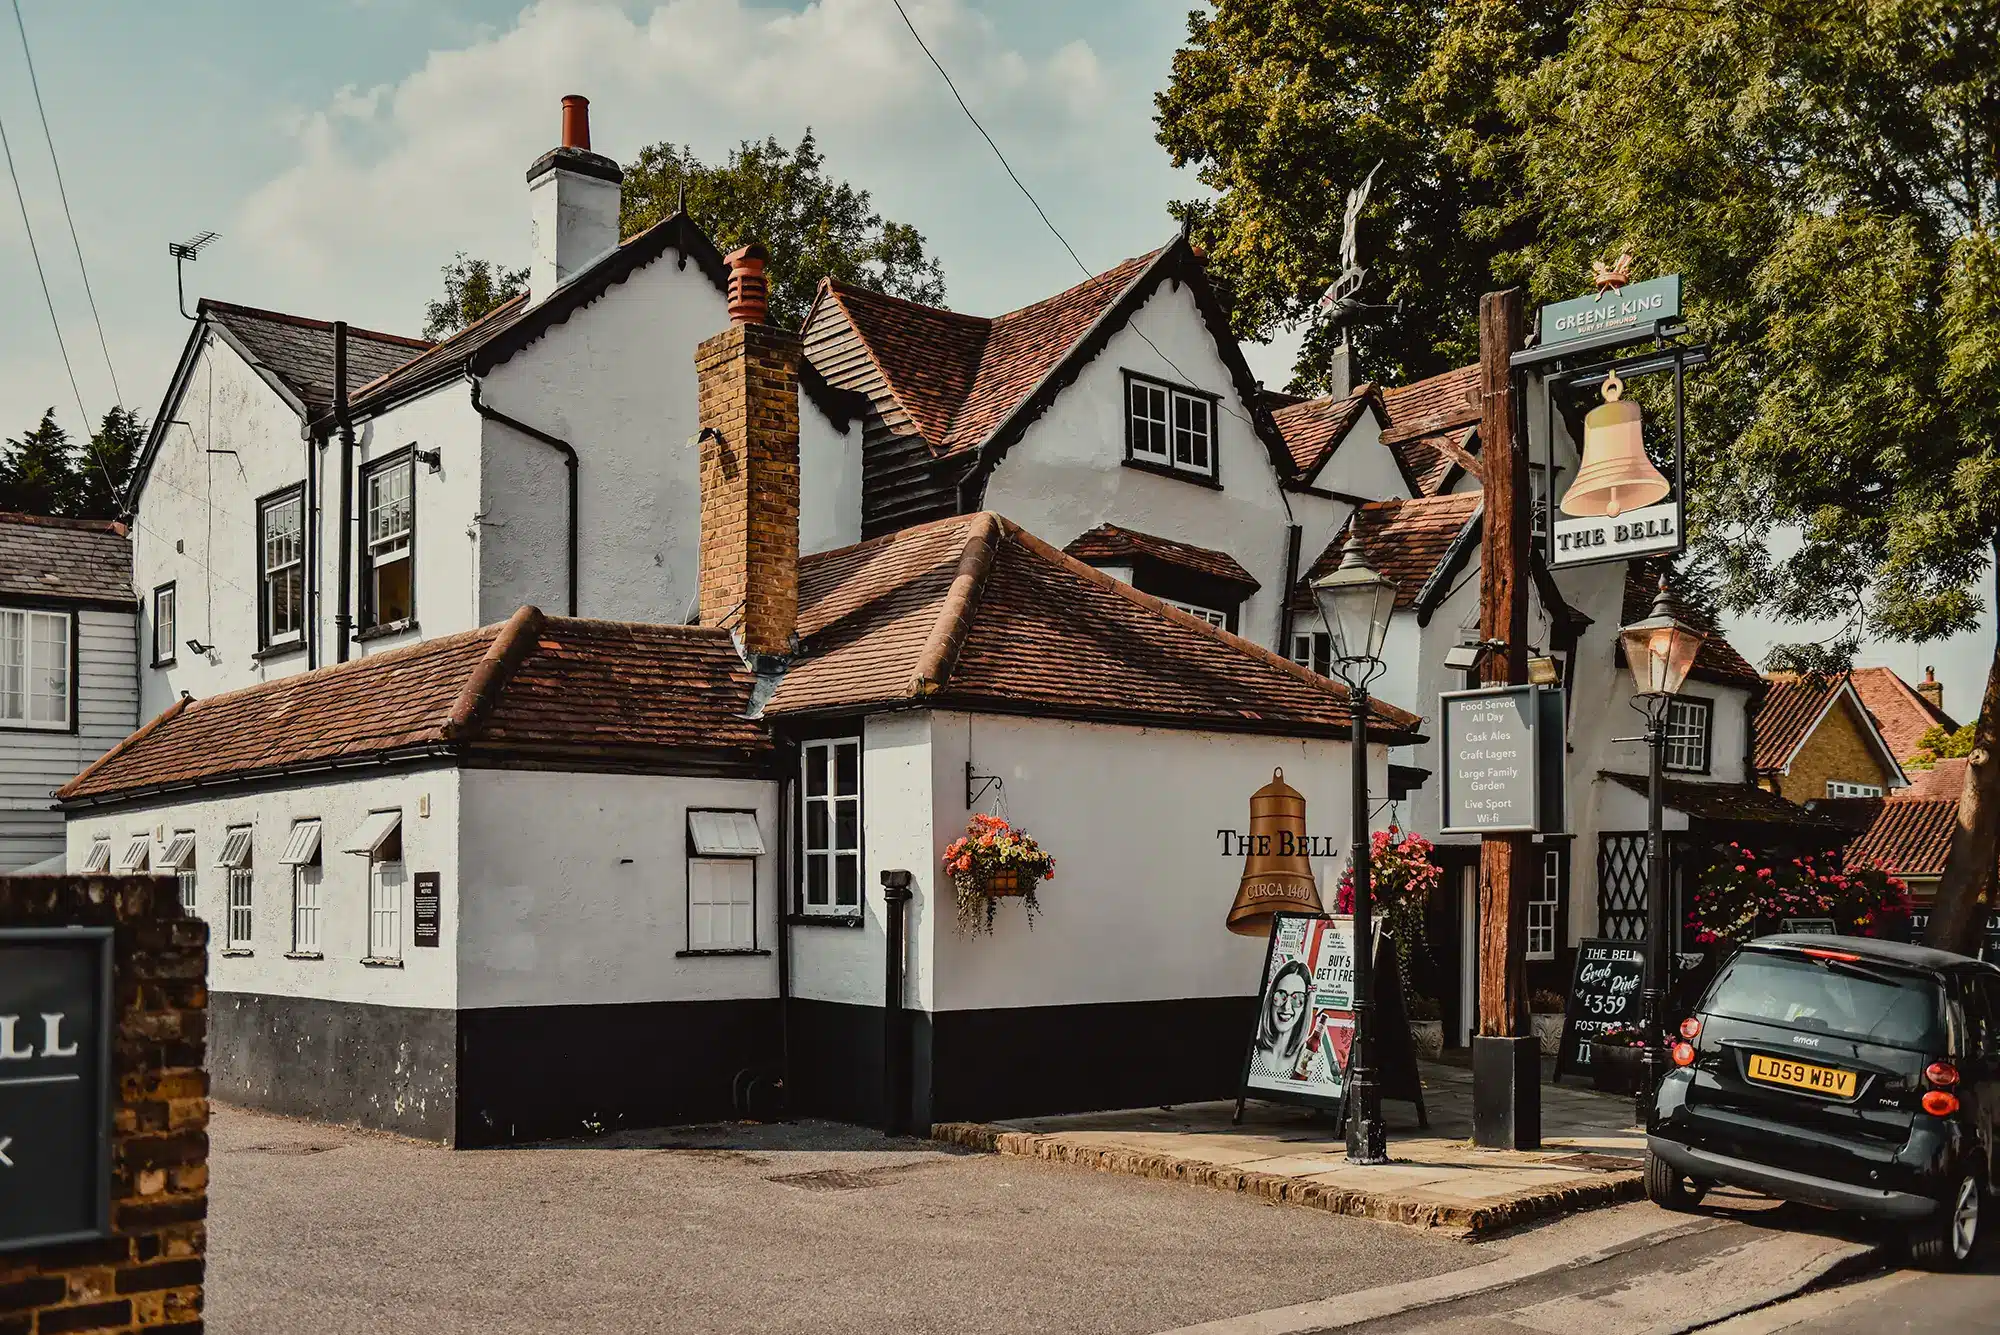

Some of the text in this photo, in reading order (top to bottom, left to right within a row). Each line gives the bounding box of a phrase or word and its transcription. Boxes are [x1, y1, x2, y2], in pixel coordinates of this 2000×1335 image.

[1555, 294, 1663, 331] GREENE KING
[1605, 315, 1638, 327] EDMUNDS
[1557, 518, 1675, 551] THE BELL
[1460, 698, 1516, 712] Food Served
[1472, 712, 1504, 724] All Day
[1465, 730, 1511, 742] Cask Ales
[1459, 749, 1517, 762] Craft Lagers
[1459, 767, 1518, 781] Large Family
[1471, 781, 1505, 791] Garden
[1464, 798, 1512, 811] Live Sport
[1476, 813, 1499, 823] Wi-fi
[1217, 829, 1338, 857] THE BELL
[1247, 882, 1311, 900] CIRCA 1460
[1587, 948, 1640, 961] THE BELL
[1328, 955, 1352, 968] BUY 5
[1316, 967, 1355, 983] GET 1 FRE
[1580, 962, 1612, 984] Grab
[1610, 974, 1641, 994] Pint
[0, 1012, 79, 1059] LL
[1793, 1035, 1820, 1047] smart
[1757, 1058, 1847, 1090] LD59 WBV
[1879, 1098, 1900, 1107] mhd
